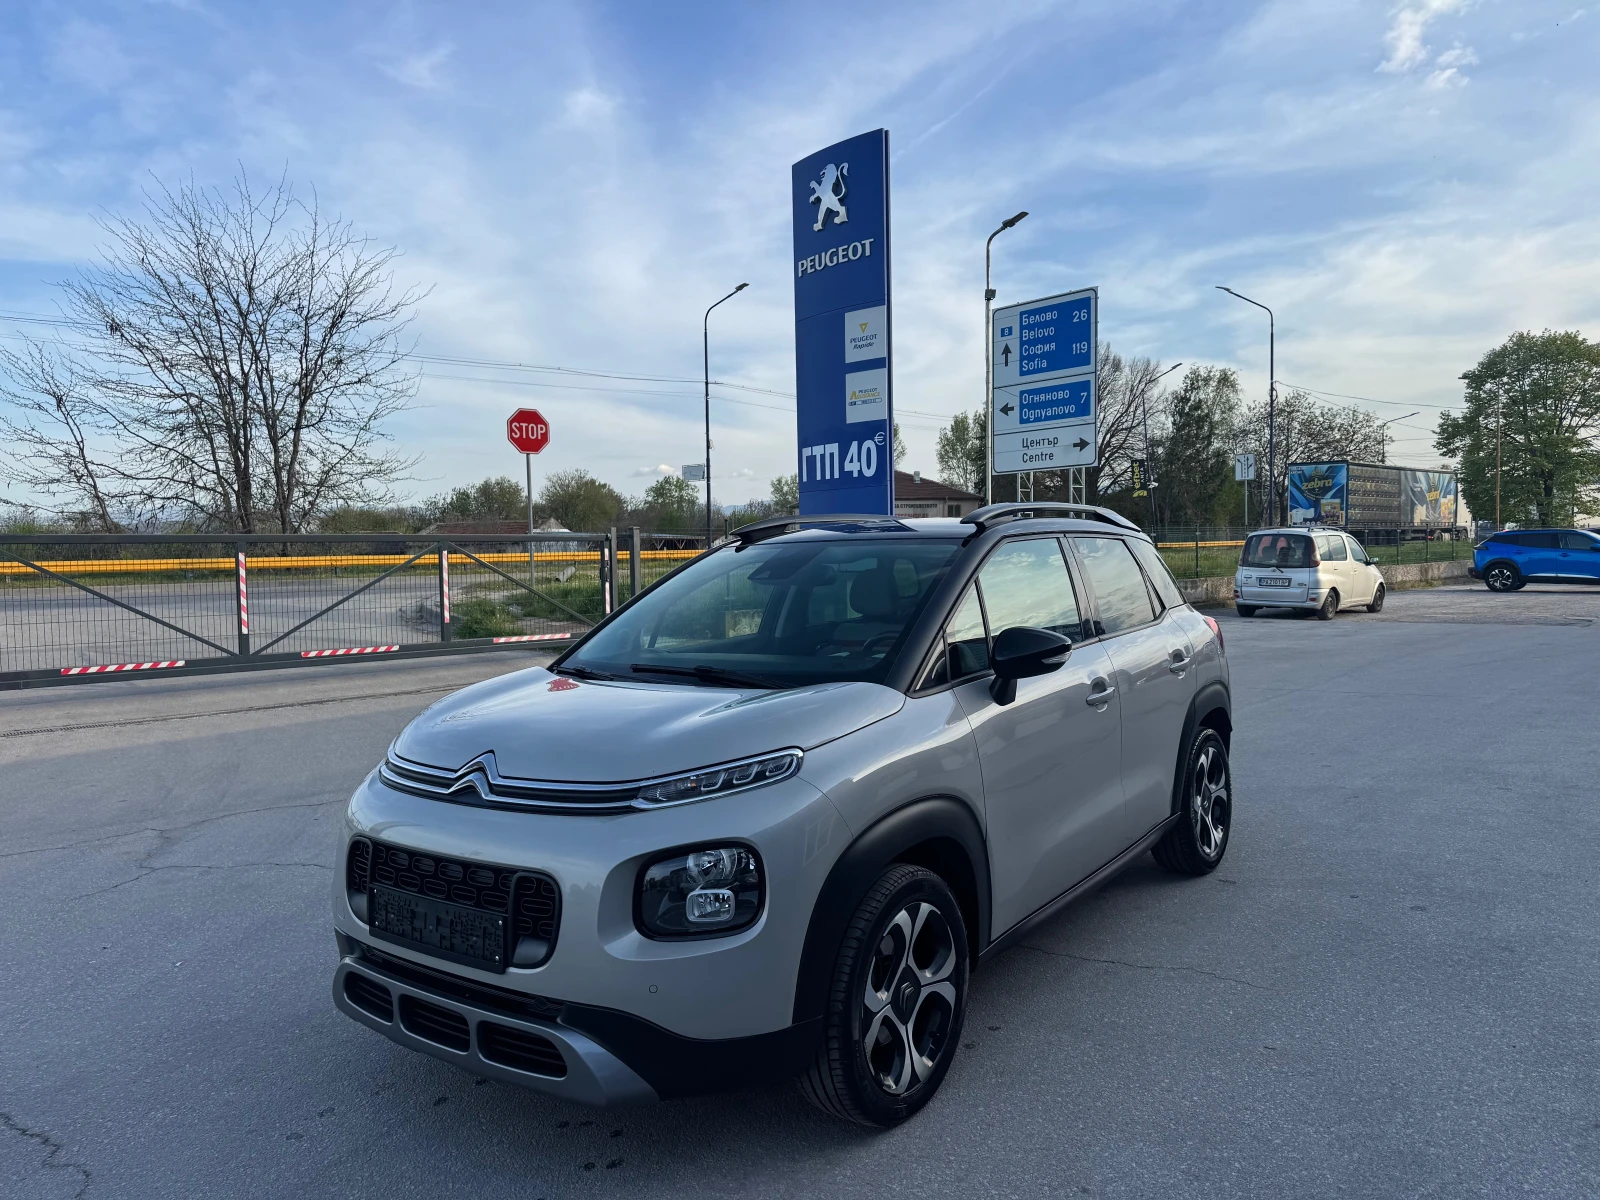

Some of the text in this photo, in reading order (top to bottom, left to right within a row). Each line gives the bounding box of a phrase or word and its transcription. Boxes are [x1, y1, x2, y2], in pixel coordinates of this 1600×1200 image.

[798, 238, 874, 277] PEUGEOT
[1022, 309, 1088, 326] Белово 26
[850, 333, 877, 344] PEUGEOT
[1022, 326, 1055, 341] Belovo
[853, 342, 875, 350] Rapide
[1022, 341, 1088, 357] София 119
[1022, 357, 1047, 371] Sofia
[1022, 388, 1088, 405] Огняново 7
[1022, 403, 1076, 421] Ognyanovo
[511, 422, 546, 440] STOP
[1022, 436, 1059, 450] Център
[802, 442, 839, 483] ГТП
[1022, 451, 1054, 464] Centre
[1302, 478, 1332, 490] zebra
